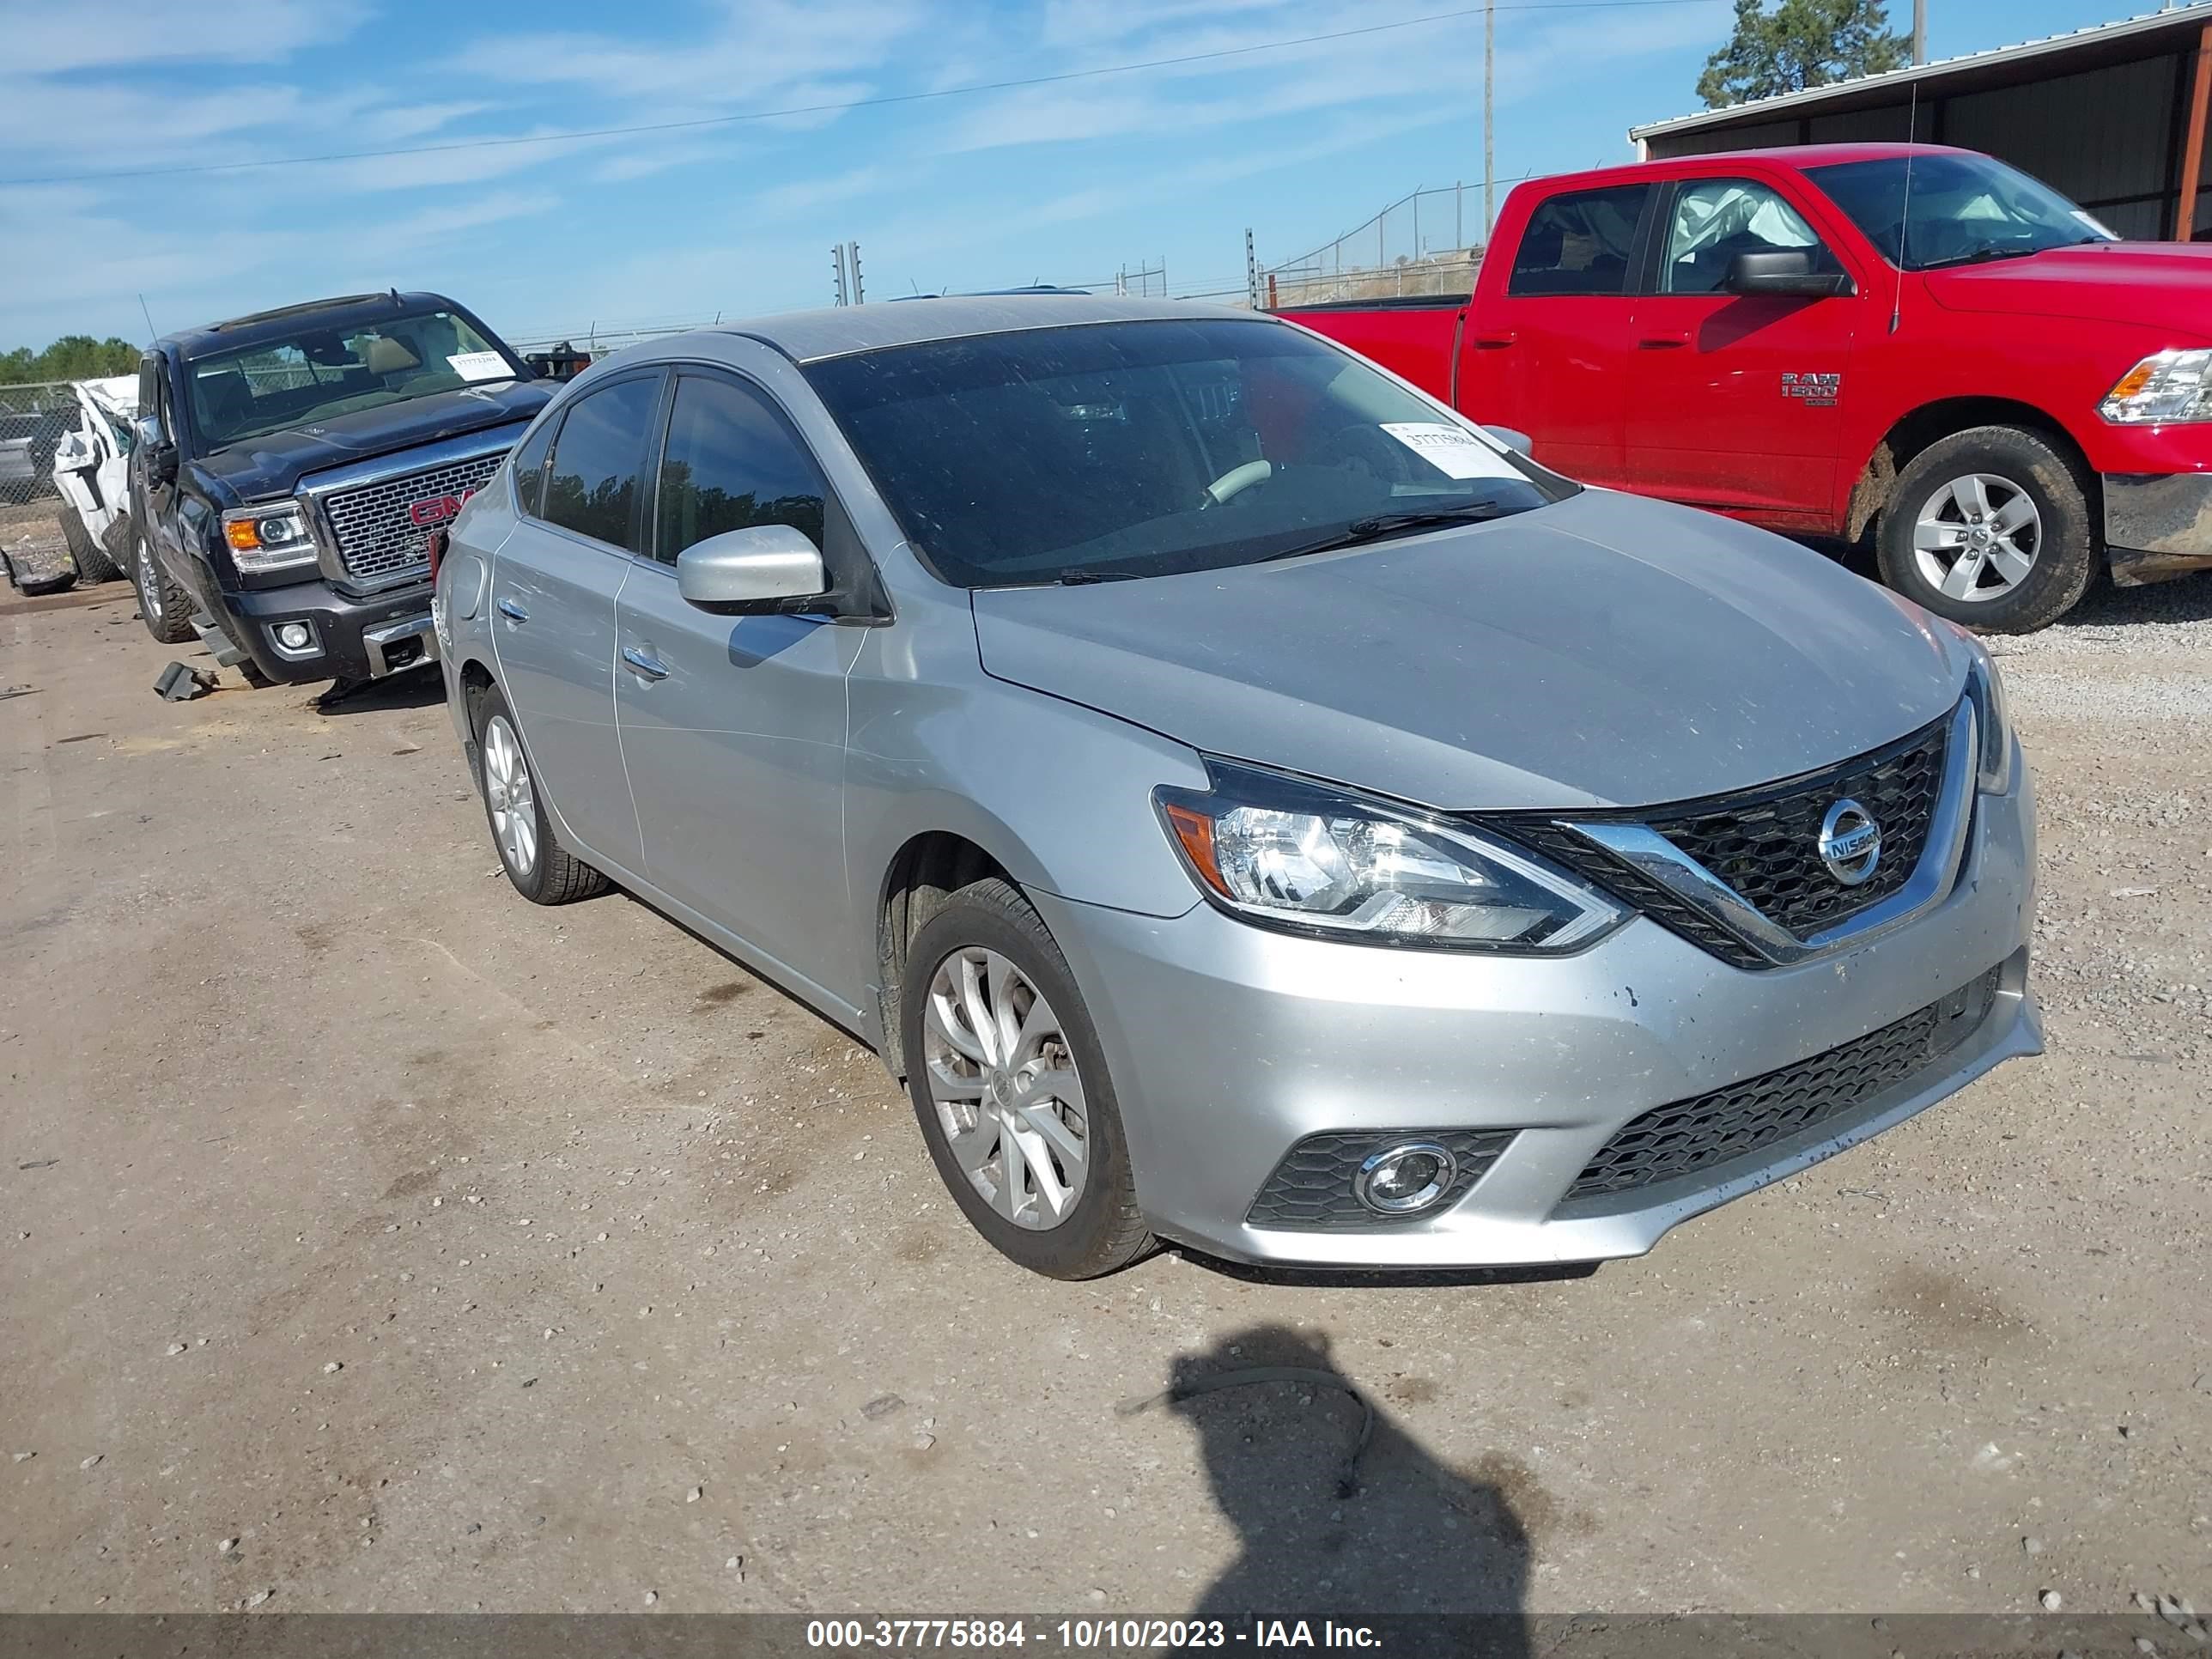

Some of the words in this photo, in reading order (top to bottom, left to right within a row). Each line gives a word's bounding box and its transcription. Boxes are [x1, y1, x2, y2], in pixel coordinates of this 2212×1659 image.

[1782, 373, 1840, 385] RAM
[1782, 385, 1837, 397] 1500
[410, 488, 476, 526] GM
[1832, 830, 1881, 857] NISSAN
